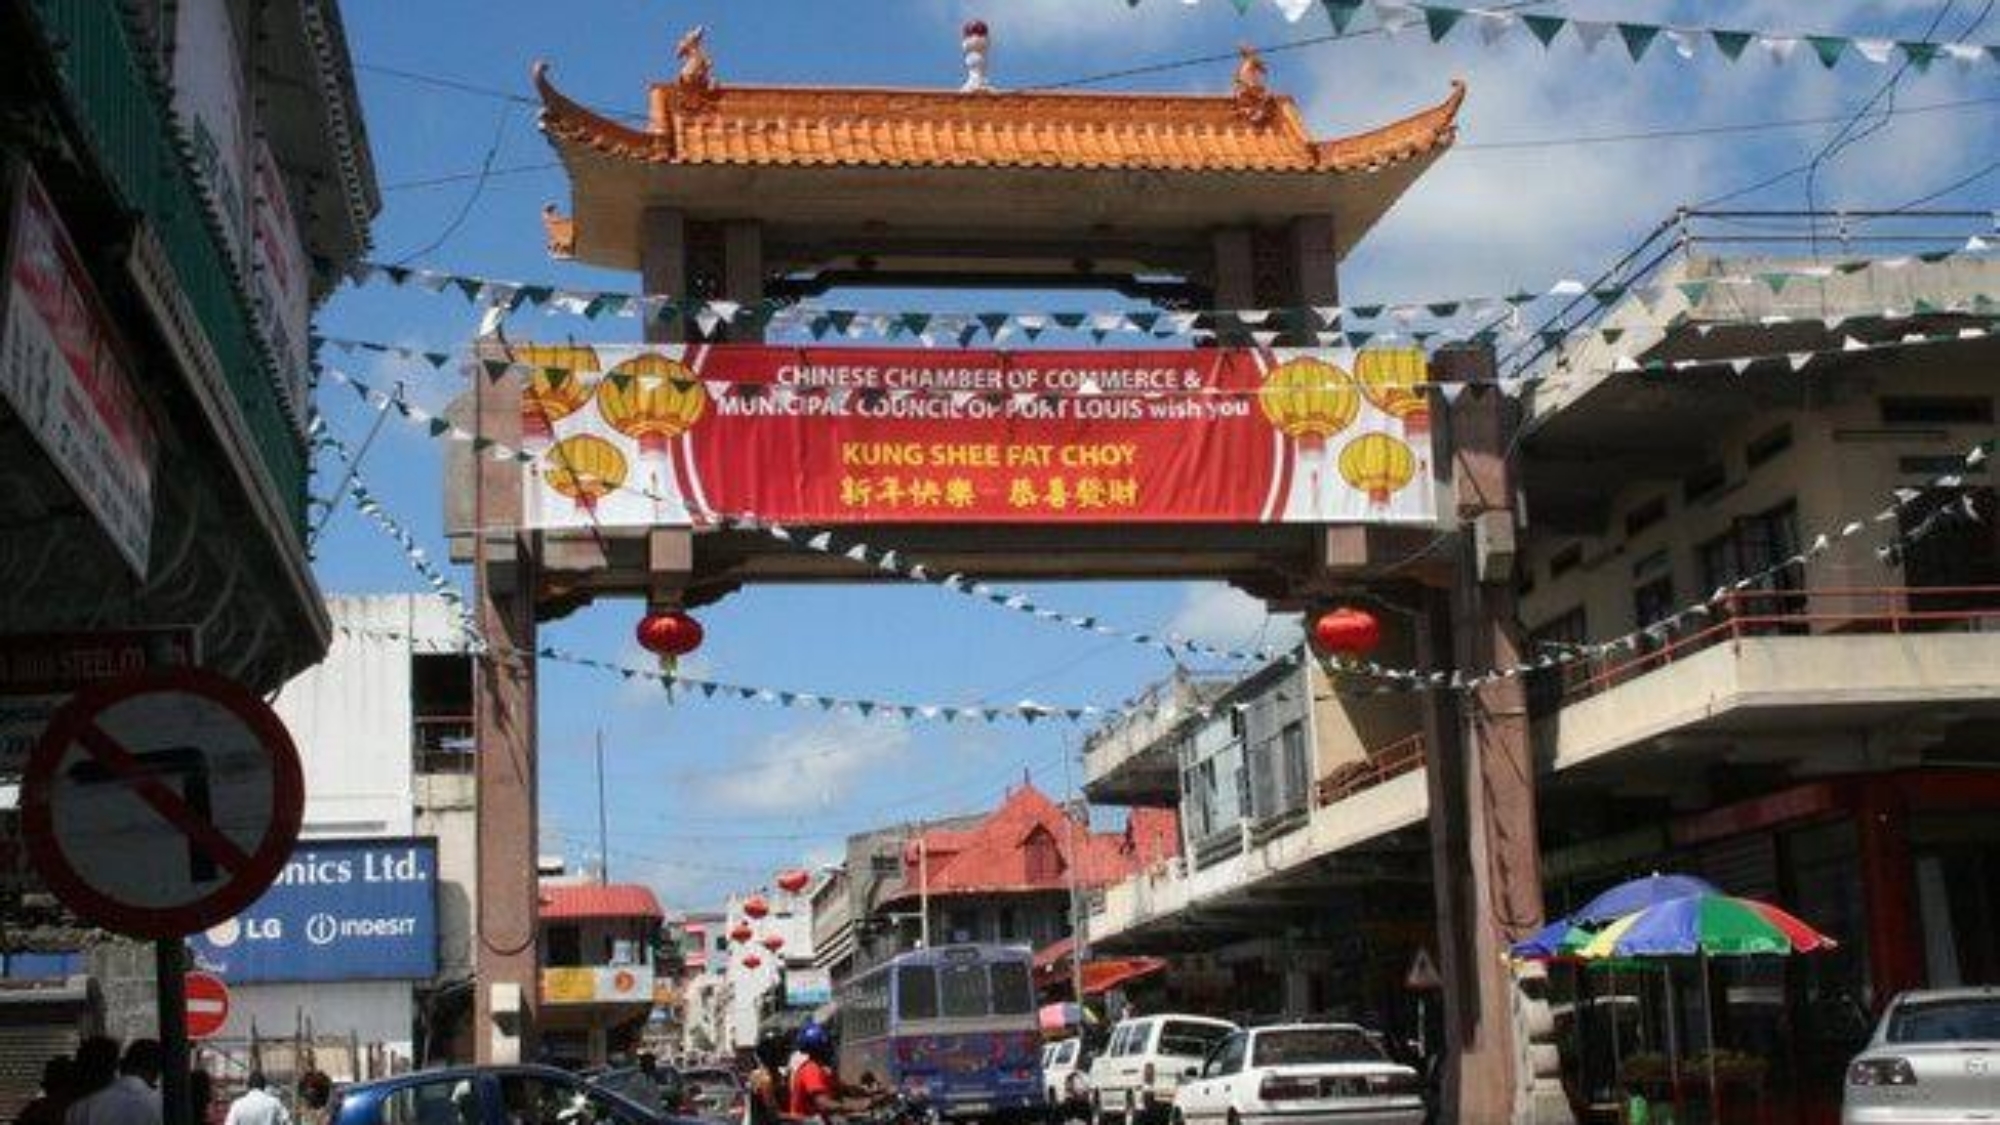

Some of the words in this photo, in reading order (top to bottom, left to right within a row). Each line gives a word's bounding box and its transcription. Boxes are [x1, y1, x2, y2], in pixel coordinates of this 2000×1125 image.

[777, 365, 878, 386] CHINESE
[885, 367, 1000, 388] CHAMBER
[1008, 369, 1038, 389] OF
[1045, 368, 1179, 389] COMMERCE
[1184, 369, 1202, 389] &
[1074, 399, 1142, 419] LOUIS
[1150, 397, 1201, 417] wish
[1205, 400, 1250, 420] you
[842, 443, 925, 466] KUNG
[930, 443, 1000, 466] SHEE
[1006, 445, 1053, 466] FAT
[1060, 443, 1138, 466] CHOY
[364, 850, 427, 882] Ltd.
[246, 917, 283, 940] LG
